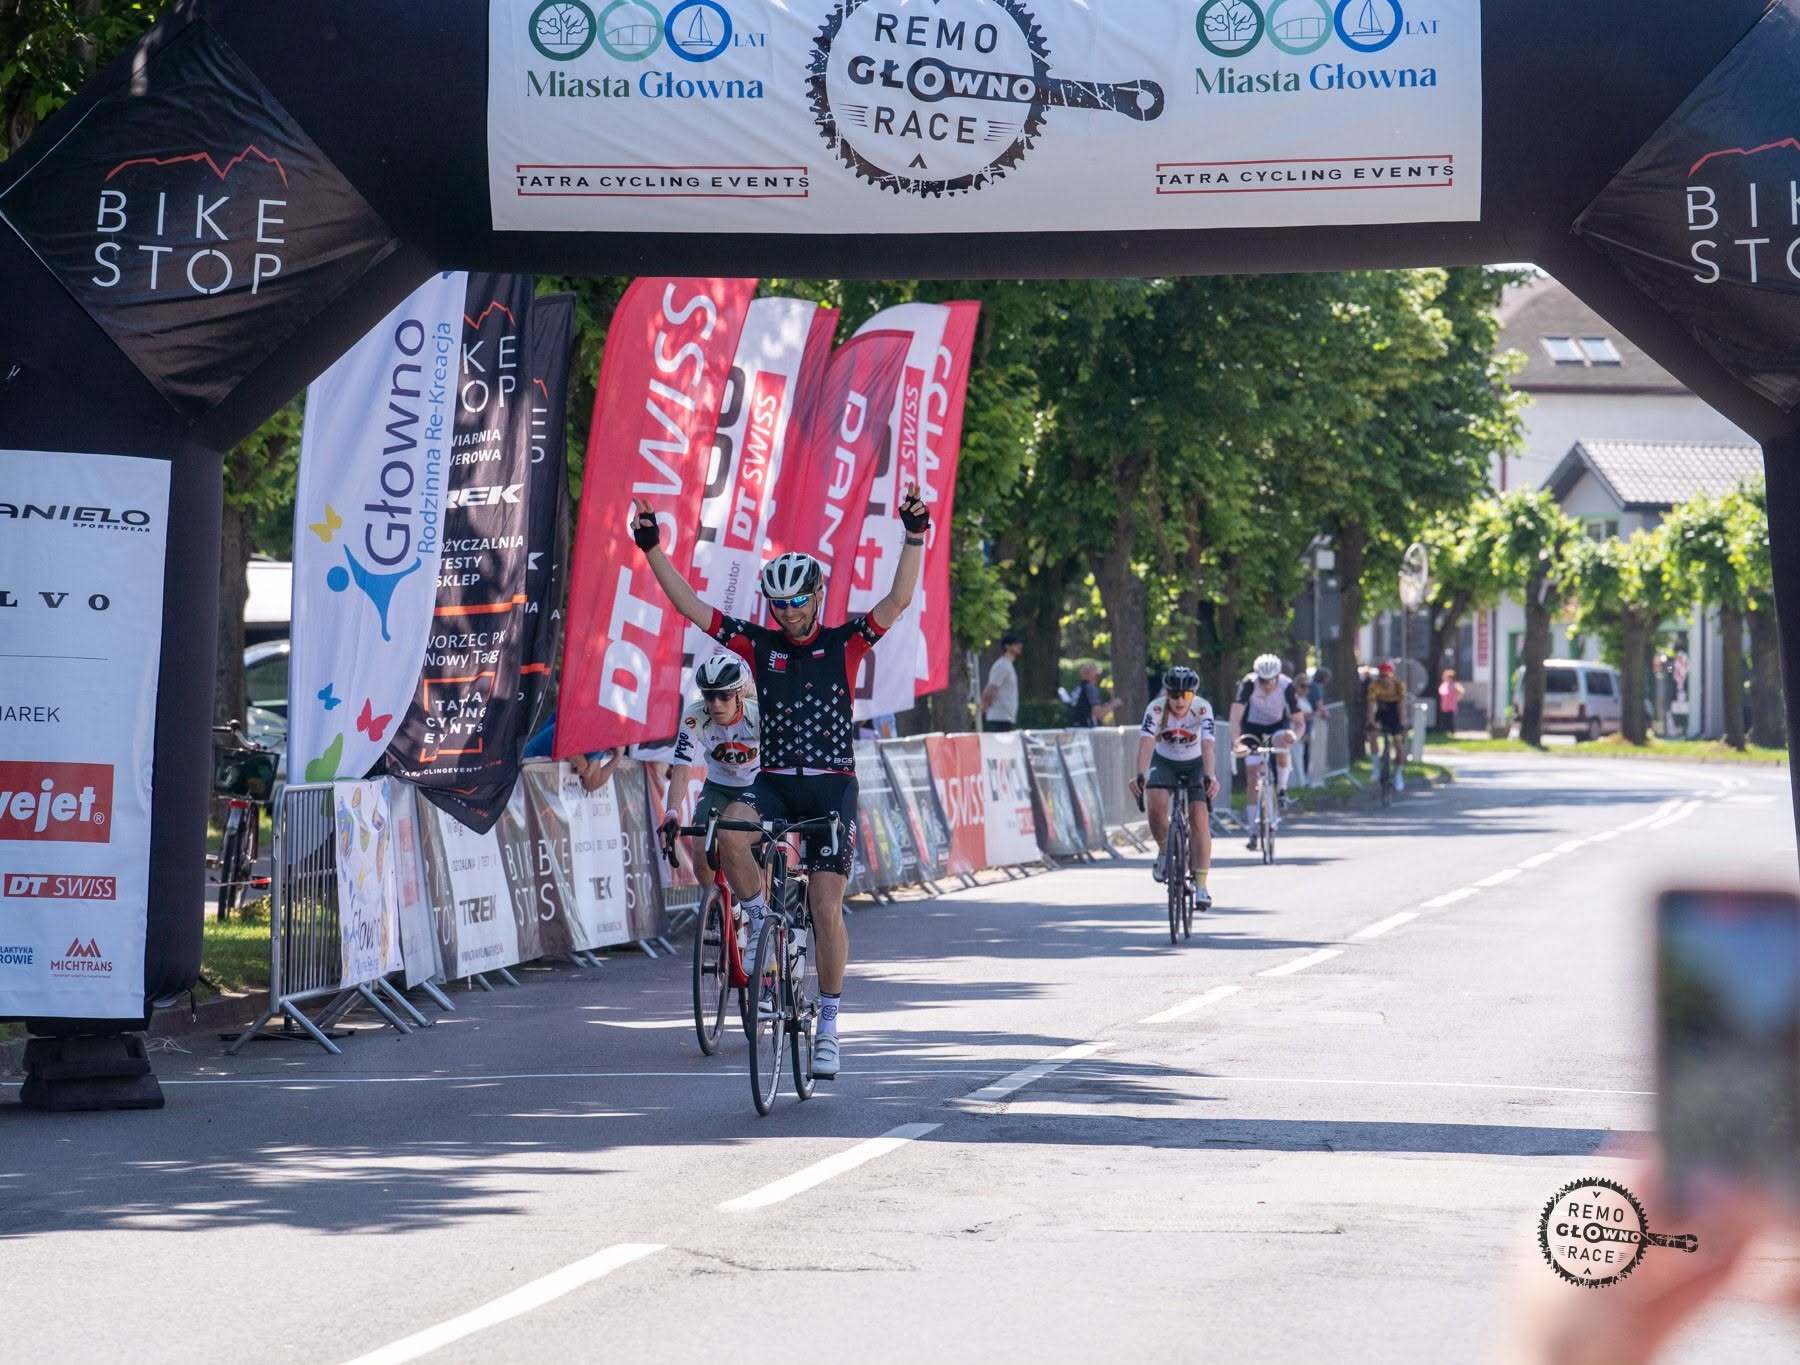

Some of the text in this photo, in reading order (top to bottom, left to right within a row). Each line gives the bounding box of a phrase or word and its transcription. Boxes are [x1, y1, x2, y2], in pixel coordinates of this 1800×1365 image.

[735, 33, 768, 48] LAT
[875, 12, 998, 54] REMO
[1406, 20, 1440, 35] LAT
[526, 70, 764, 99] Miasta Głowna
[847, 55, 1037, 100] GŁOWNO
[1195, 62, 1438, 95] Miasta Głowna
[873, 106, 977, 144] RACE
[516, 175, 809, 189] TATRA CYCLING EVENTS
[1155, 164, 1455, 185] TATRA CYCLING EVENTS
[97, 190, 288, 244] BIKE
[92, 242, 282, 295] STOP
[417, 321, 455, 554] Rodzinna Re-Kreacja
[626, 281, 718, 557] SWISS
[743, 391, 777, 485] SWISS
[902, 384, 920, 464] SWISS
[364, 319, 426, 565] Głowno
[73, 522, 151, 533] SPORTSWEAR
[731, 486, 757, 542] DT
[424, 652, 470, 668] Nowy
[598, 565, 664, 725] DT
[0, 706, 61, 722] AREK
[8, 876, 113, 898] DT SWISS
[50, 959, 113, 972] MICHTRANS
